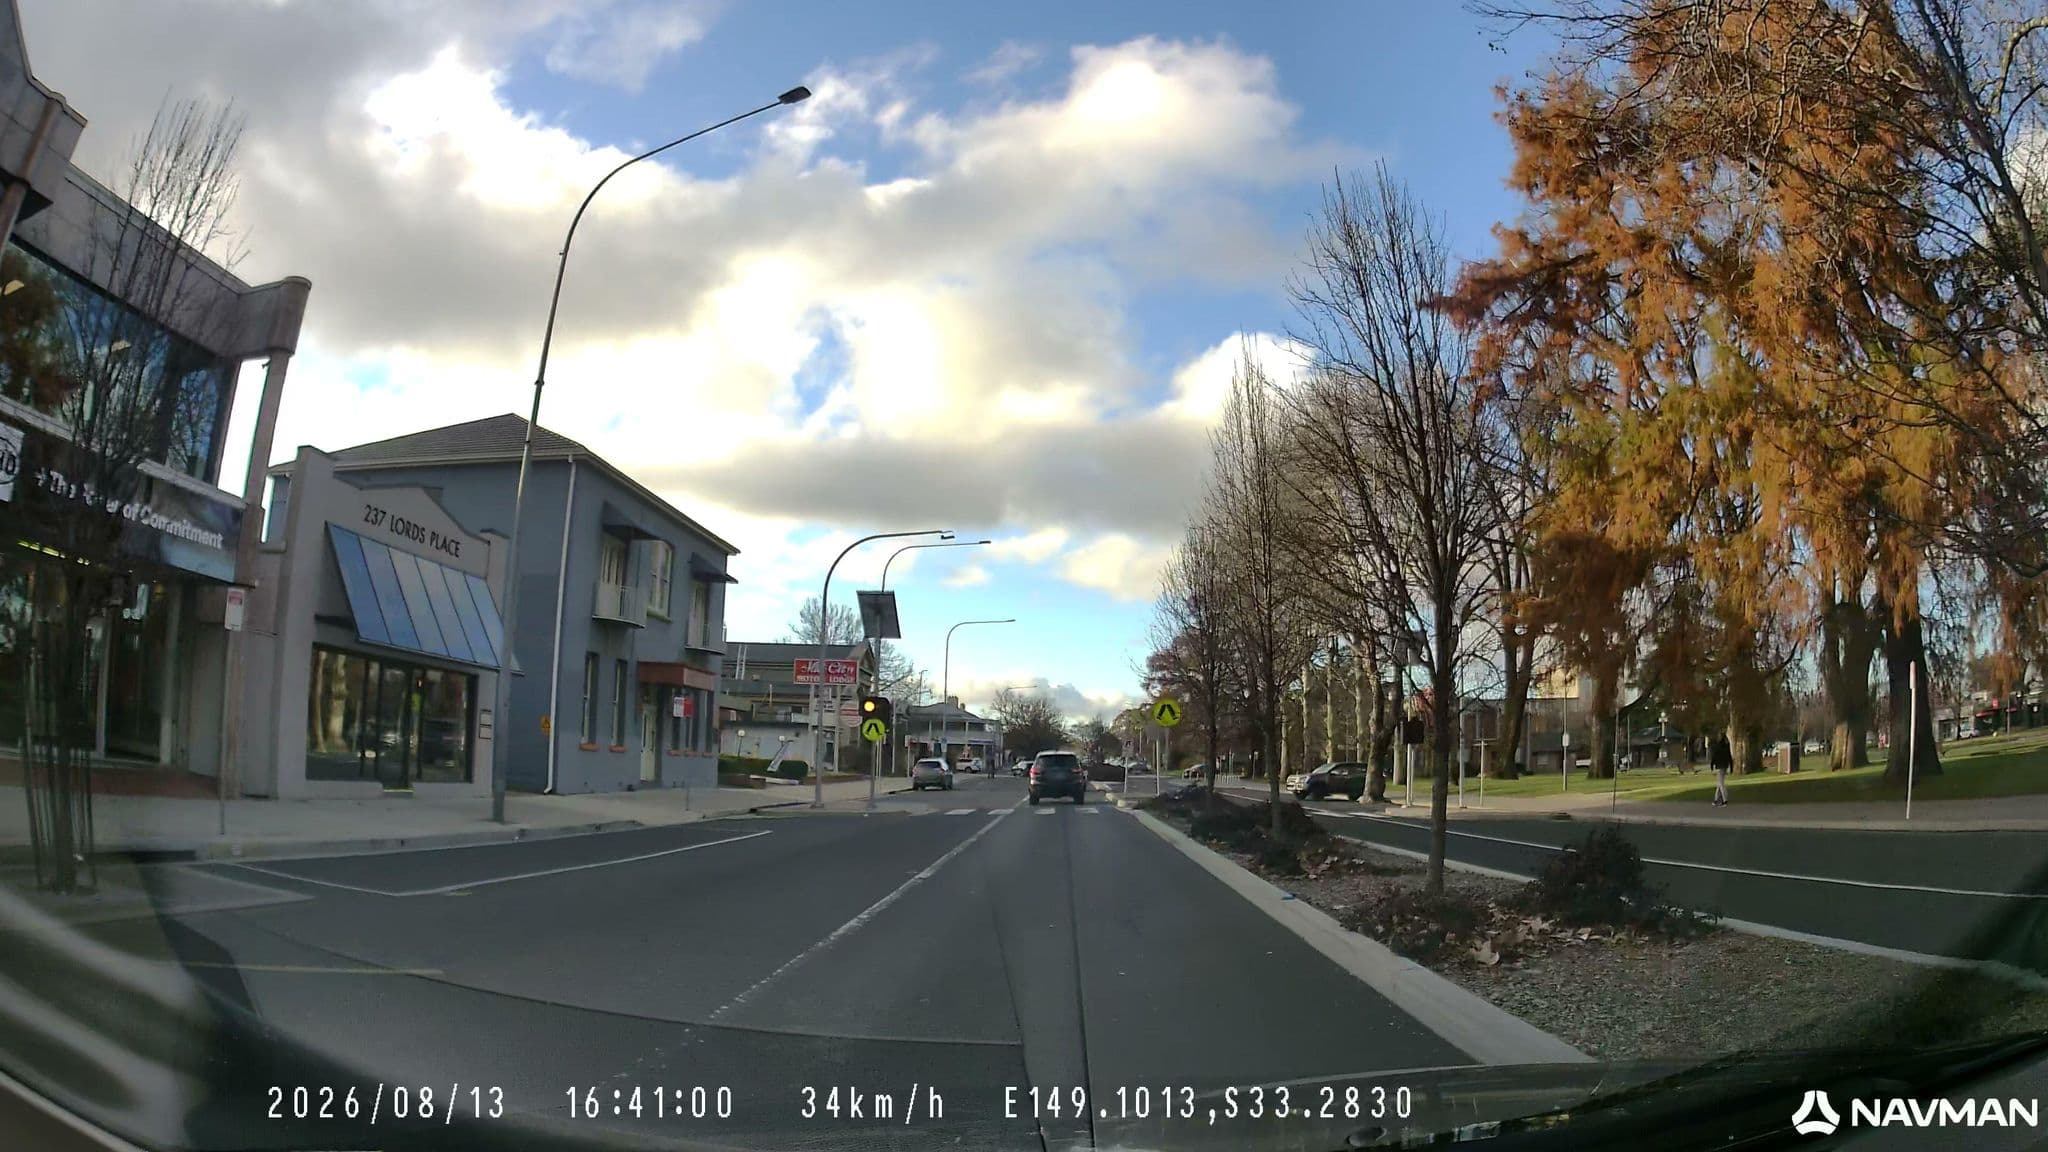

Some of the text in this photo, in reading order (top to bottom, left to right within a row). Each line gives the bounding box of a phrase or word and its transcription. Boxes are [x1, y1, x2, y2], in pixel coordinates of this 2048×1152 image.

[81, 482, 119, 513] Per
[122, 502, 141, 521] of
[141, 503, 224, 550] Commitment
[363, 504, 461, 558] 237 LORDS PLACE
